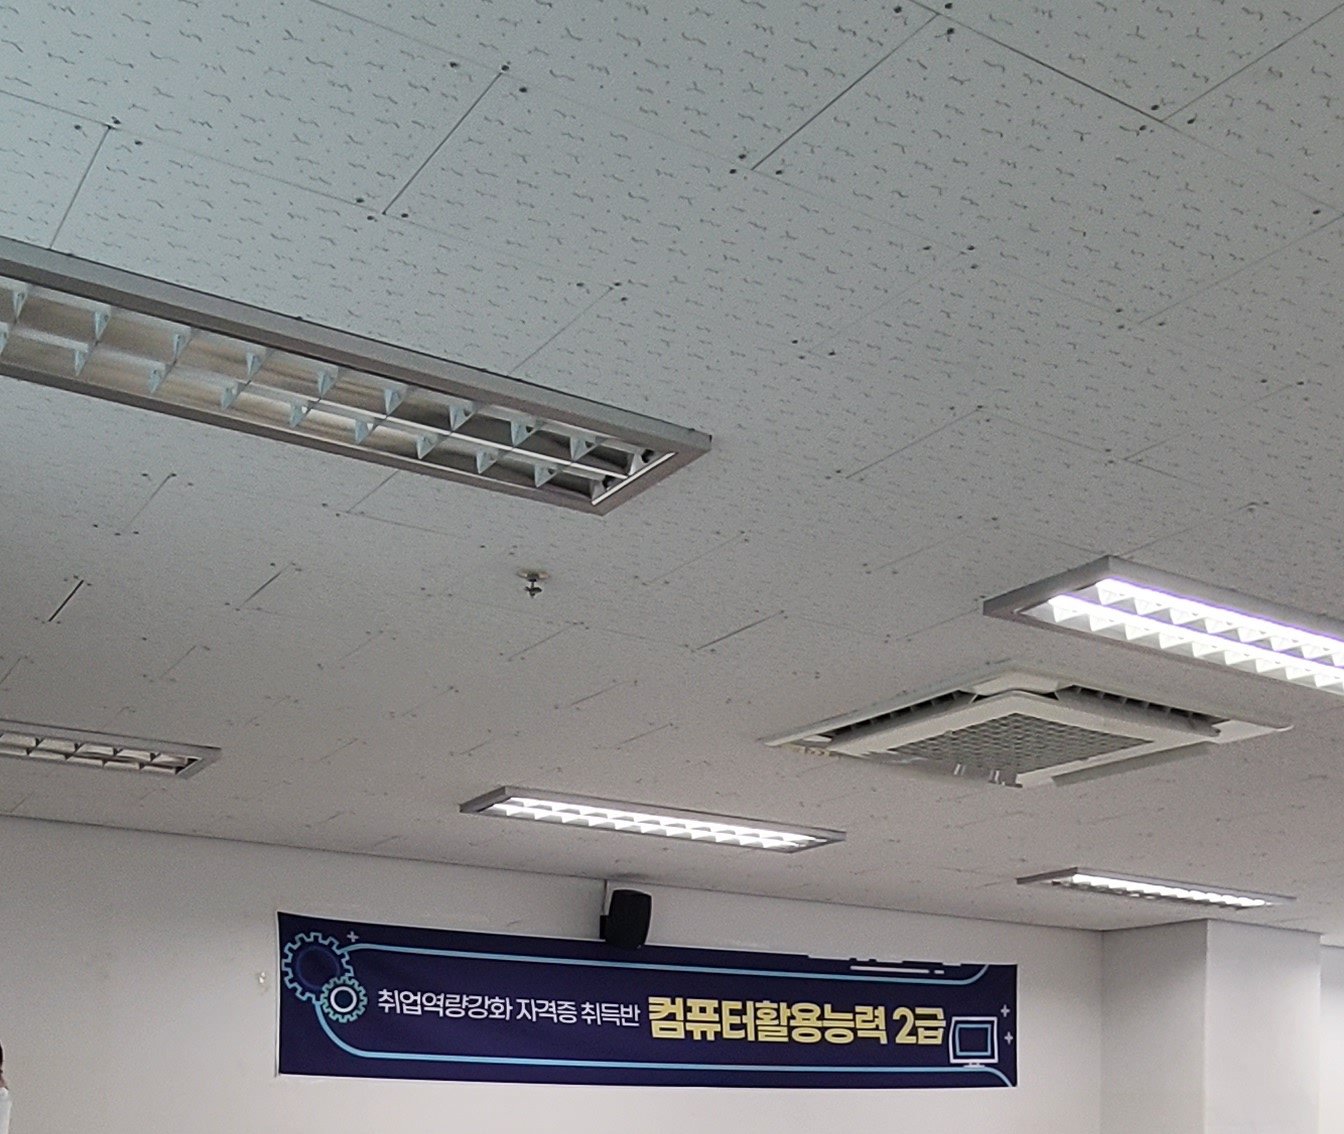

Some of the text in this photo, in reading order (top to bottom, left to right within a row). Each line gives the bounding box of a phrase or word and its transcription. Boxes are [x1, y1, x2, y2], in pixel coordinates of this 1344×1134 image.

[377, 988, 947, 1046] 취업역량강화 자격증 취득반 컴퓨터활용능력 2급
